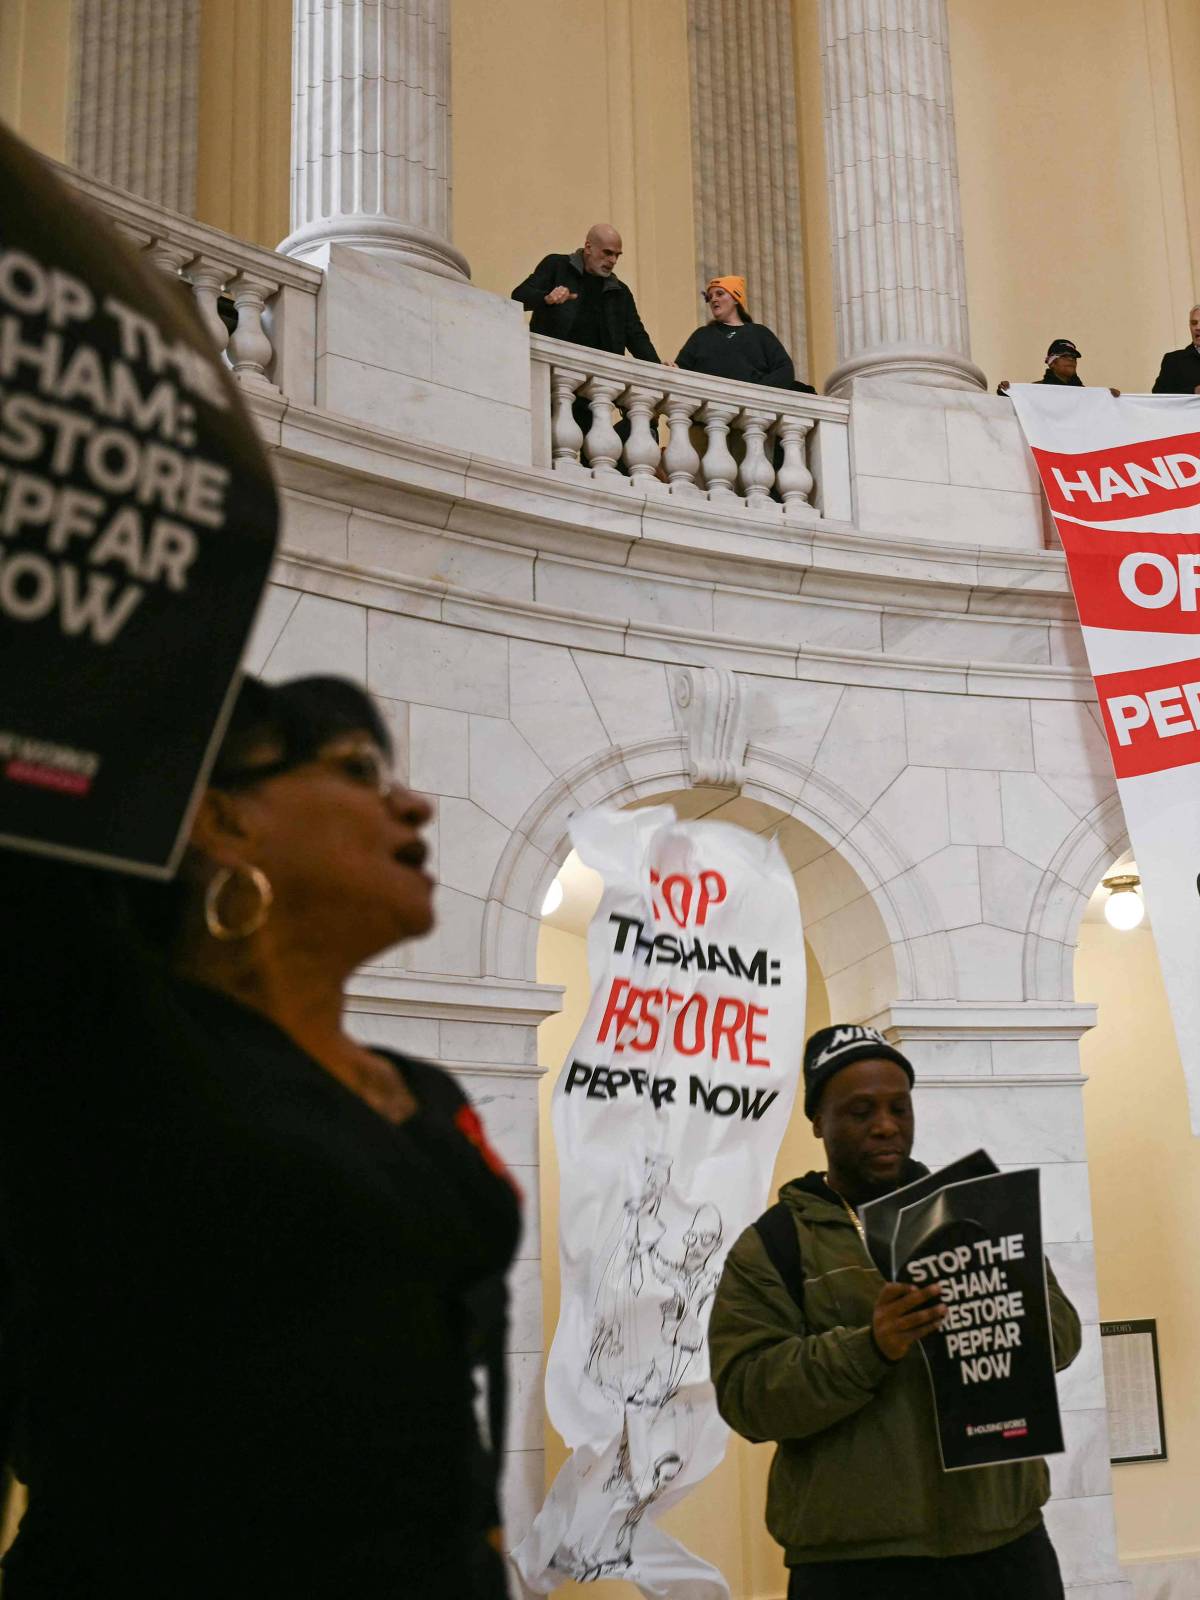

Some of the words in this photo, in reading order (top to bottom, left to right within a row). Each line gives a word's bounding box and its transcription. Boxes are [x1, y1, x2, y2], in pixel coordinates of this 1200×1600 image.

[0, 249, 95, 327] OP
[0, 315, 197, 446] HAM:
[0, 391, 231, 528] STORE
[0, 464, 198, 591] PFAR
[0, 551, 144, 644] OW
[689, 1073, 779, 1121] NOW
[907, 1246, 972, 1282] STOP
[974, 1234, 1025, 1266] THE
[939, 1267, 1008, 1303] SHAM:
[946, 1322, 1021, 1358] PEPFAR
[960, 1352, 1011, 1384] NOW
